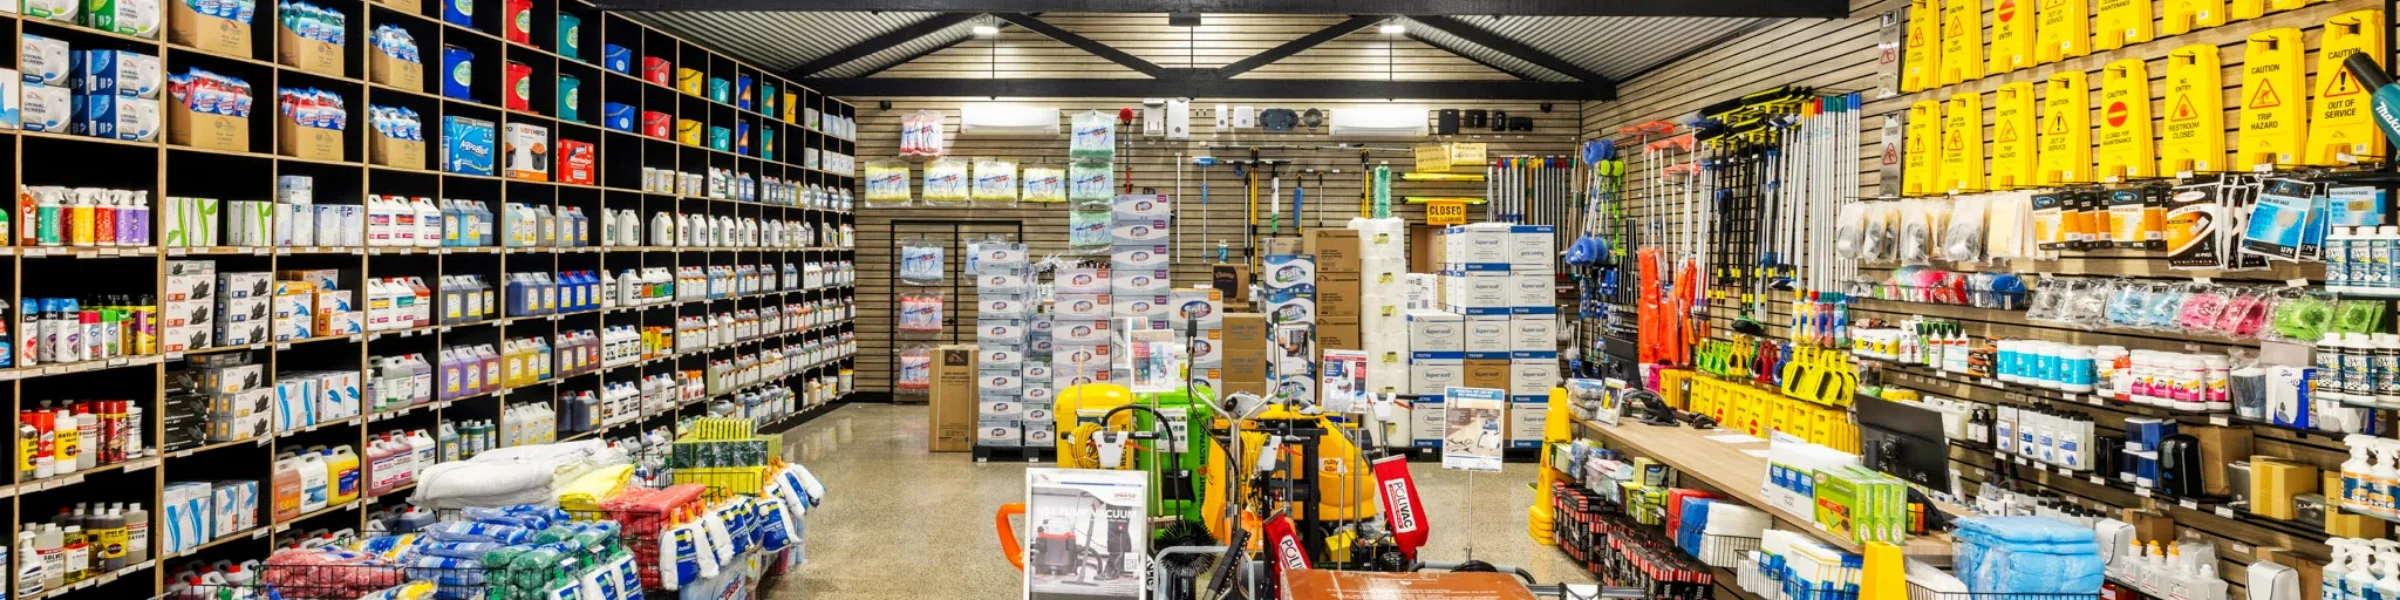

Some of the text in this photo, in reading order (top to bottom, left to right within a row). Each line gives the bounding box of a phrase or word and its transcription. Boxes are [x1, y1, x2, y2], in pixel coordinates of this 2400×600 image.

[2328, 47, 2361, 60] CAUTION
[2250, 64, 2280, 74] CAUTION
[2176, 84, 2192, 93] ENTRY
[2107, 90, 2128, 98] CAUTION
[2328, 98, 2355, 110] OUT OF
[2257, 112, 2272, 121] TRIP
[2324, 108, 2356, 119] SERVICE
[2168, 122, 2200, 132] RESTROOM
[2250, 121, 2279, 130] HAZARD
[2173, 130, 2195, 140] CLOSED
[1430, 206, 1462, 215] CLOSED
[1393, 481, 1412, 528] POLIVAC
